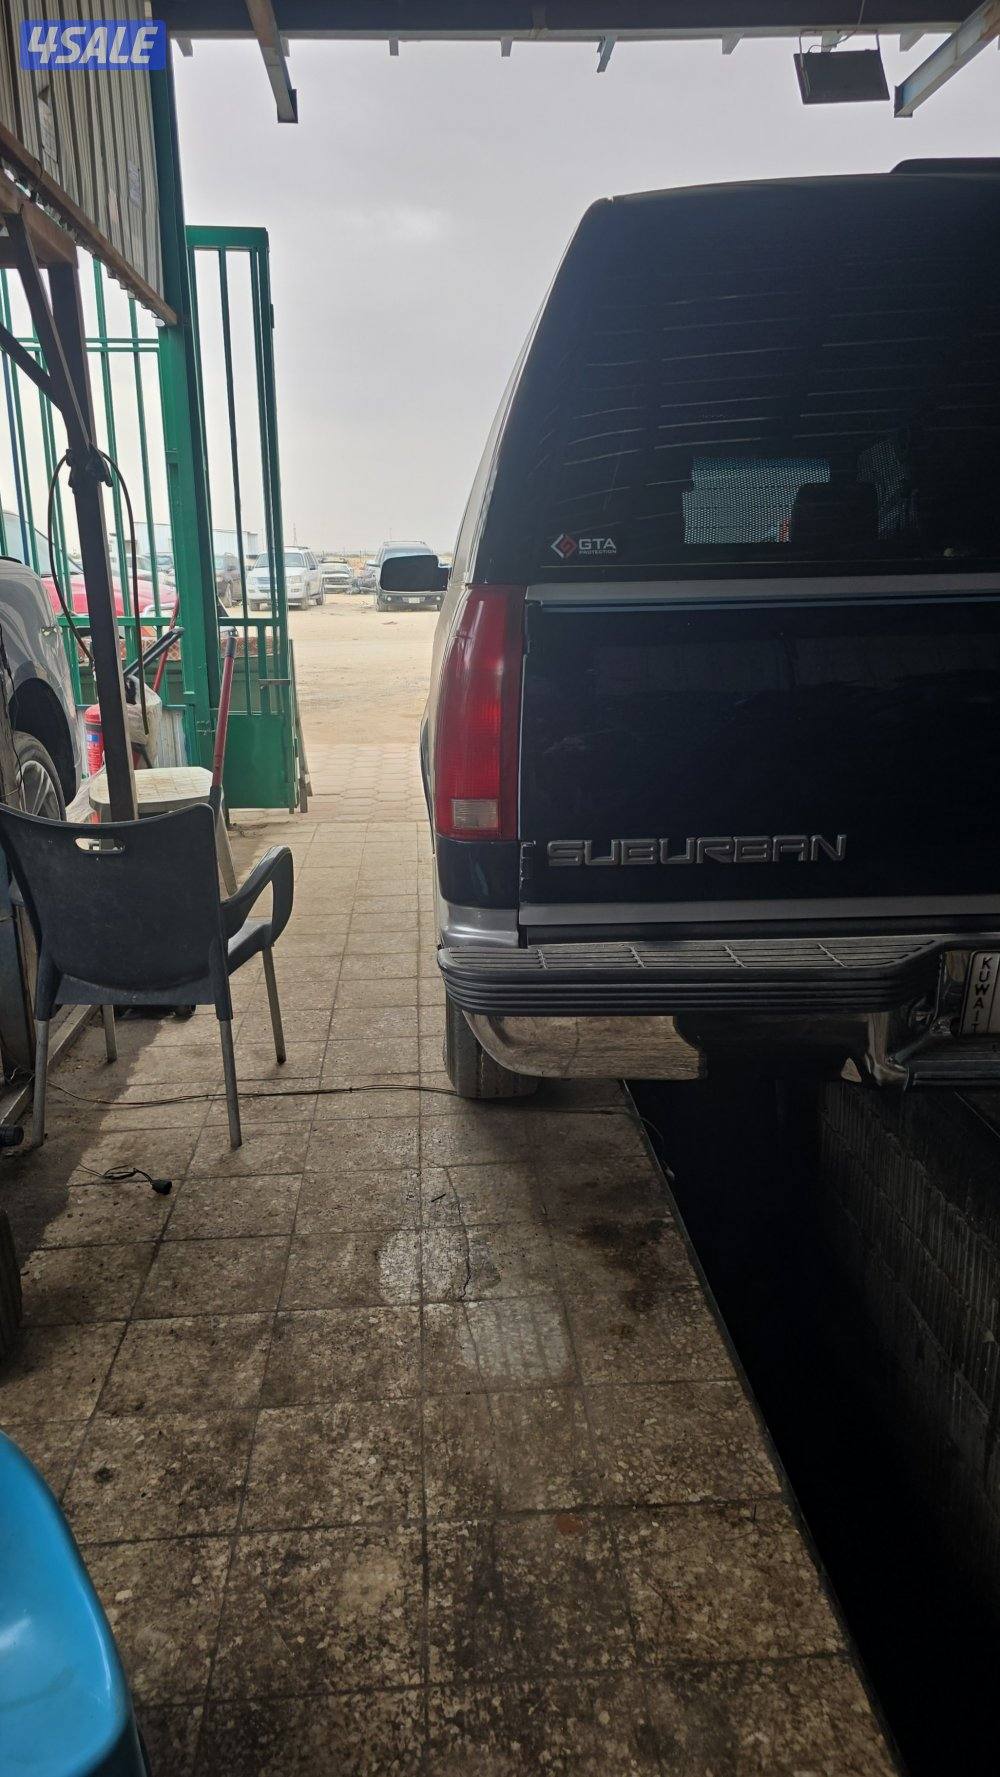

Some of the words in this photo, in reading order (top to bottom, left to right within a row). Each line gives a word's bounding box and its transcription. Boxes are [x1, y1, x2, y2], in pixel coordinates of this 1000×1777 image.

[578, 538, 616, 550] GTA
[546, 834, 847, 867] SUBURBAN
[967, 956, 992, 1033] KUWAIT
